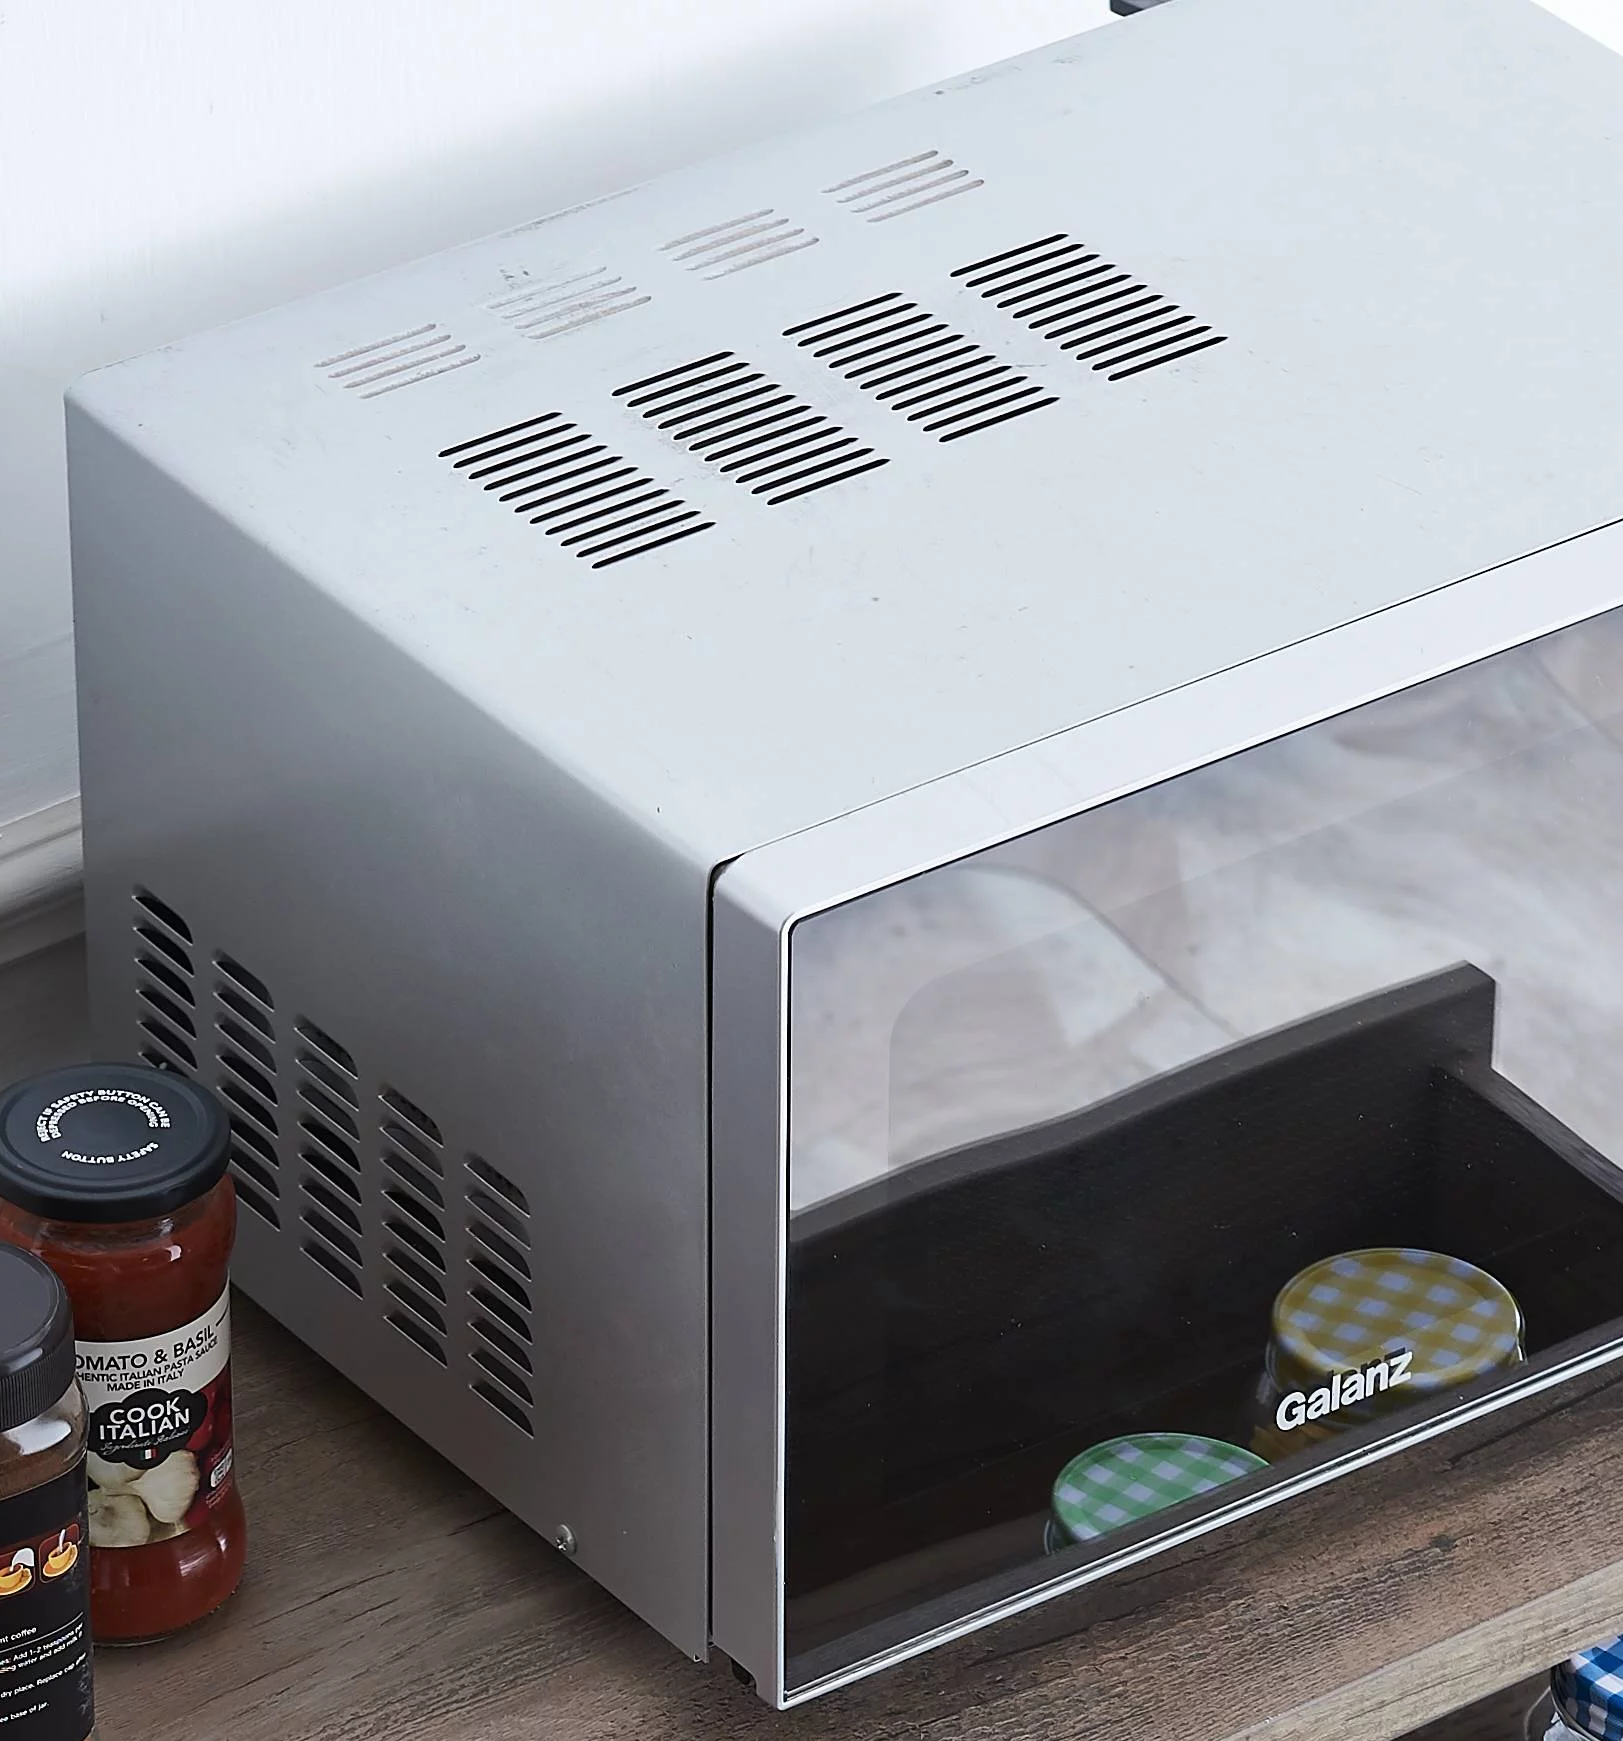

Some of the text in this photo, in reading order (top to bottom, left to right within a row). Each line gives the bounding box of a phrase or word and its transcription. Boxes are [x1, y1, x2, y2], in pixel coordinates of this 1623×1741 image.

[51, 1090, 94, 1108] SAFETY
[97, 1089, 150, 1103] BUTTON
[148, 1101, 168, 1117] CAN
[160, 1117, 171, 1128] BE
[78, 1095, 125, 1104] BEFORE
[127, 1099, 159, 1128] OPENING
[61, 1142, 159, 1164] SAFETY BUTTON
[76, 1324, 214, 1370] OMATO & BASIL
[77, 1336, 218, 1382] HENTIC ITALIAN PASTA SAUCE
[107, 1369, 184, 1392] MADE IN ITALY
[1276, 1350, 1413, 1431] Galanz
[99, 1408, 190, 1440] ITALIAN
[110, 1396, 180, 1425] COOK
[10, 1627, 37, 1641] coffee
[13, 1651, 28, 1661] Add
[40, 1650, 52, 1660] and
[0, 1690, 13, 1699] dry
[14, 1683, 35, 1696] place.
[36, 1670, 63, 1686] Replace
[10, 1709, 28, 1720] base
[29, 1704, 37, 1713] of
[38, 1701, 50, 1712] jar.
